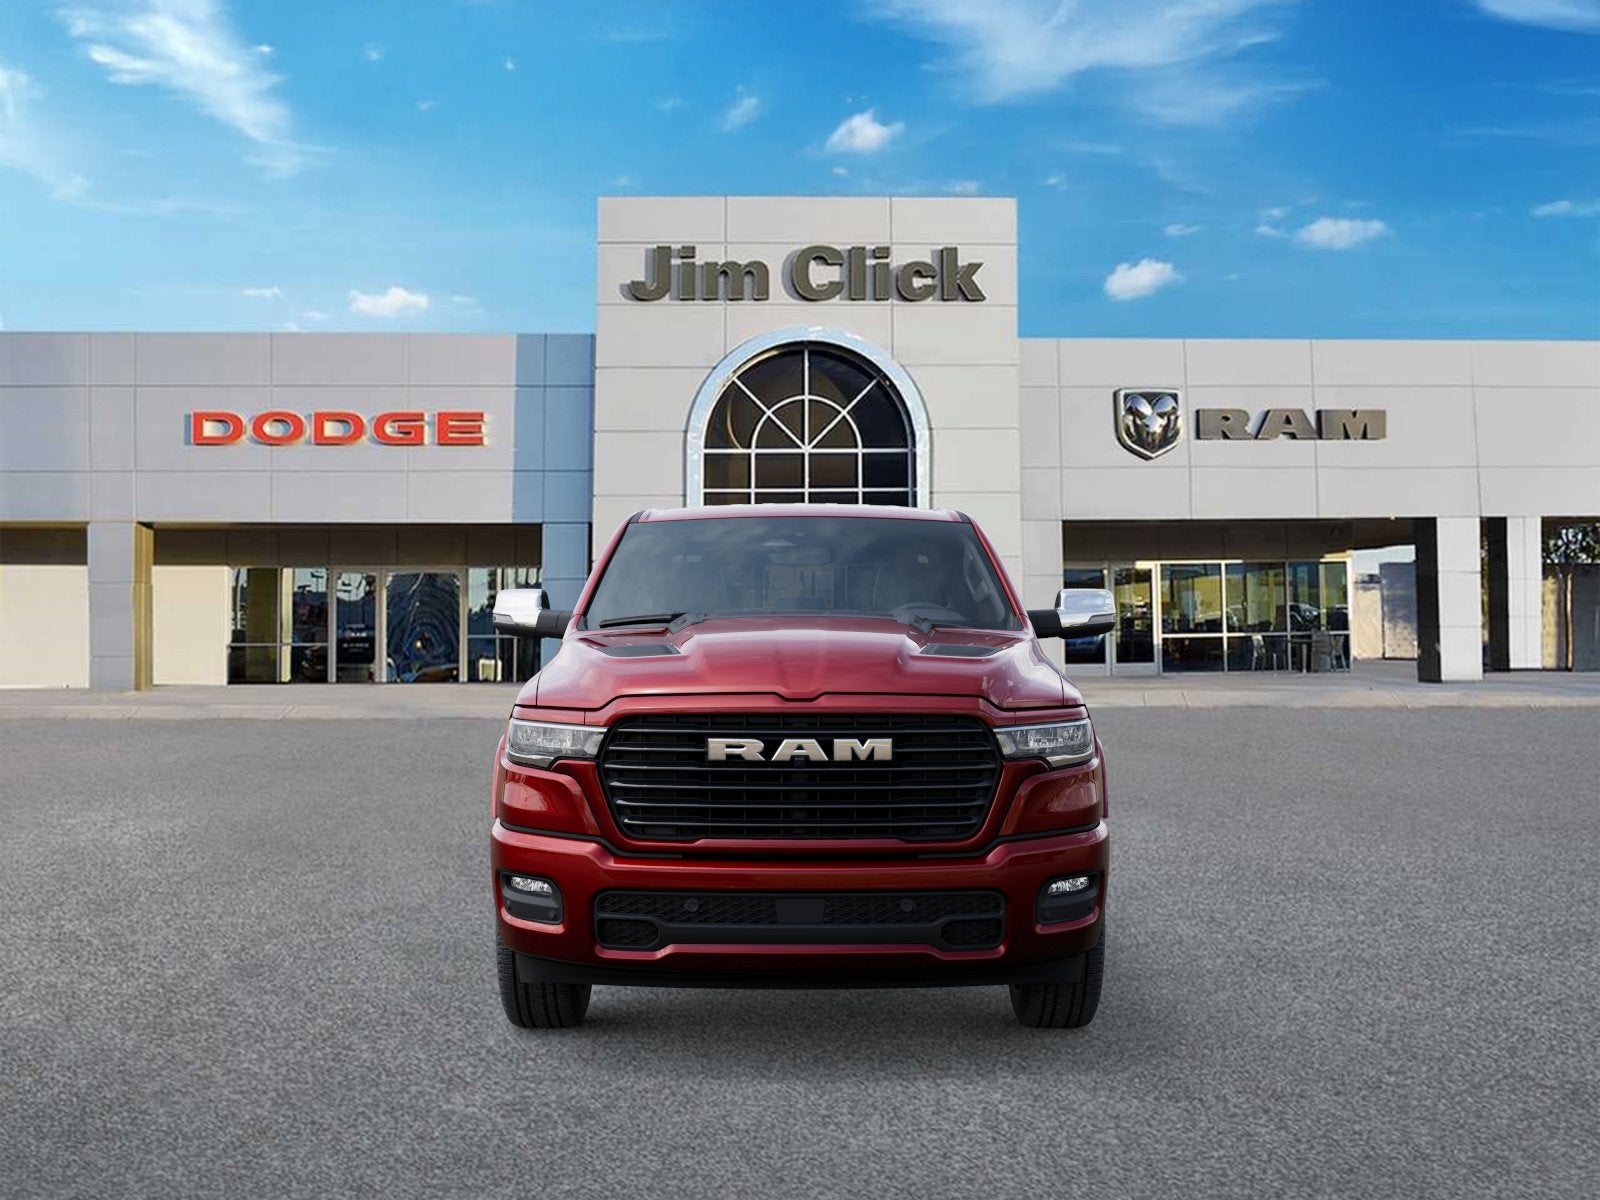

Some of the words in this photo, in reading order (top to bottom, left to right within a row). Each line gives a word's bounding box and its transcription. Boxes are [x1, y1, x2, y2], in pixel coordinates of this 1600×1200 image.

[623, 245, 769, 302] Jim
[786, 245, 987, 302] Click
[190, 410, 487, 446] DODGE
[1196, 408, 1387, 440] RAM
[707, 738, 893, 761] RAM
